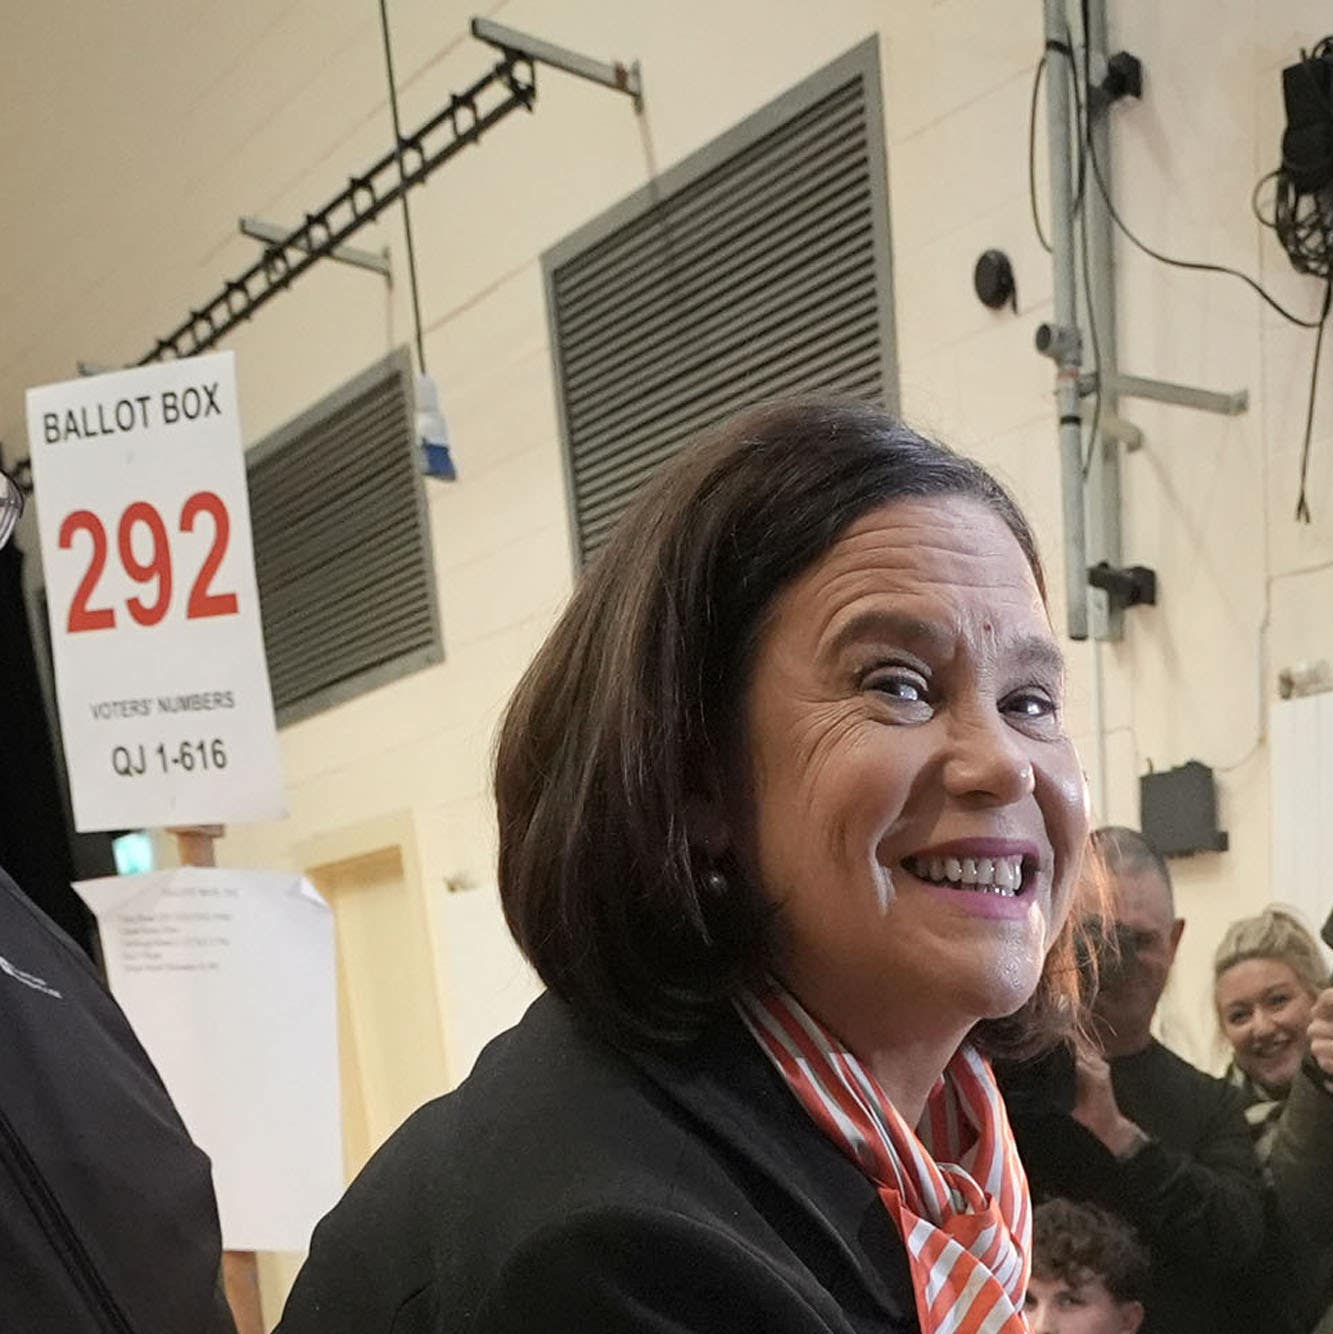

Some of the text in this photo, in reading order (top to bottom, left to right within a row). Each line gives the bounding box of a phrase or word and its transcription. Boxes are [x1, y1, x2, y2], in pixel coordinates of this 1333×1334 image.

[43, 382, 222, 444] BALLOT BOX
[58, 491, 239, 634] 292
[157, 691, 235, 713] NUMBERS
[112, 738, 227, 777] QJ 1-616
